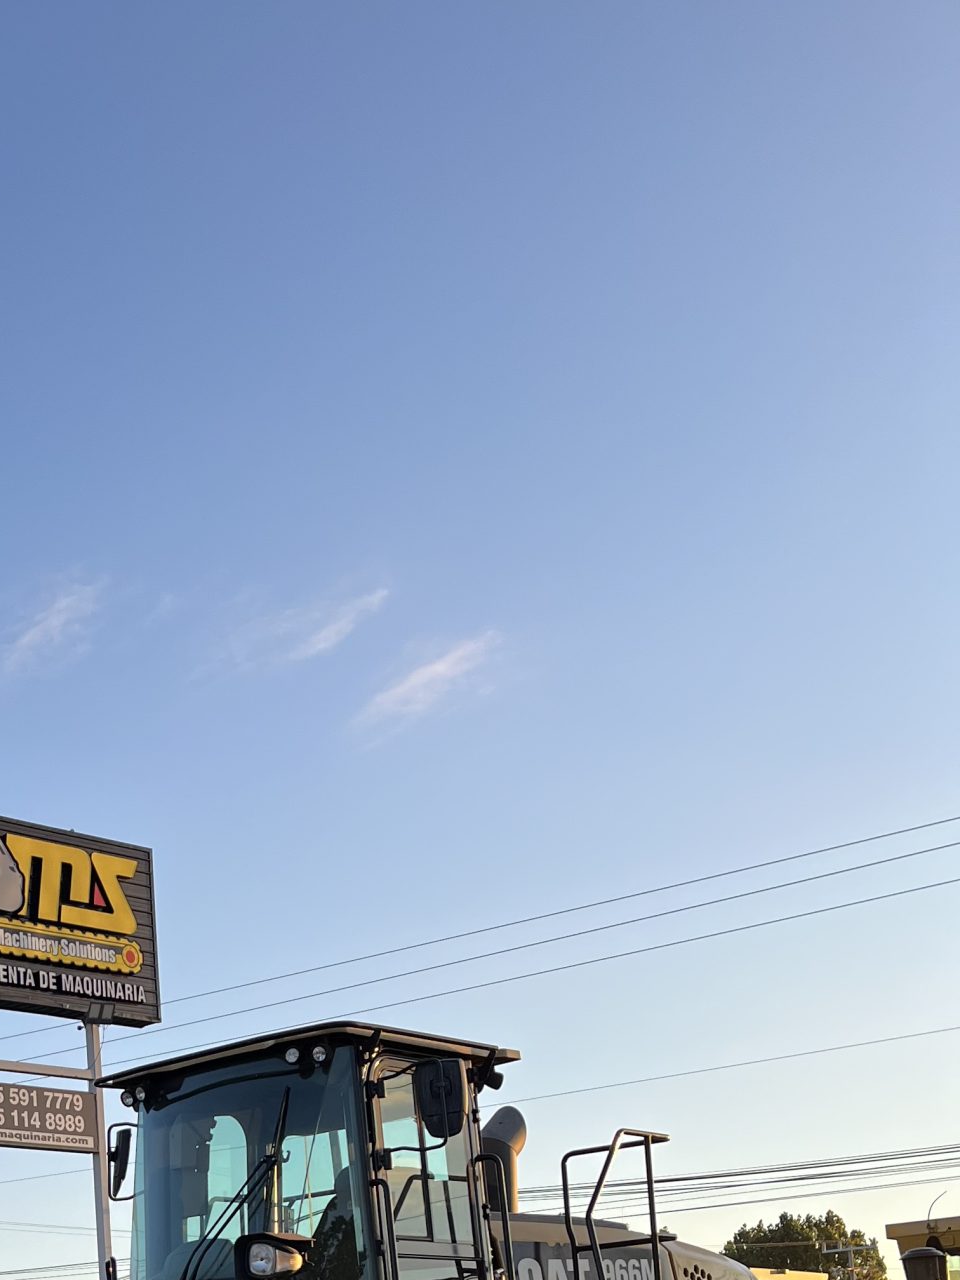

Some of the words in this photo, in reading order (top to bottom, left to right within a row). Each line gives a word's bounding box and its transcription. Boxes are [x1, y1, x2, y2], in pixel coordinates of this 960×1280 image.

[61, 937, 117, 963] Solutions
[39, 971, 58, 990] DE
[62, 974, 147, 1003] MAQUINARIA
[9, 1088, 38, 1107] 591
[44, 1091, 83, 1111] 7779
[11, 1109, 40, 1128] 114
[45, 1112, 85, 1133] 8989
